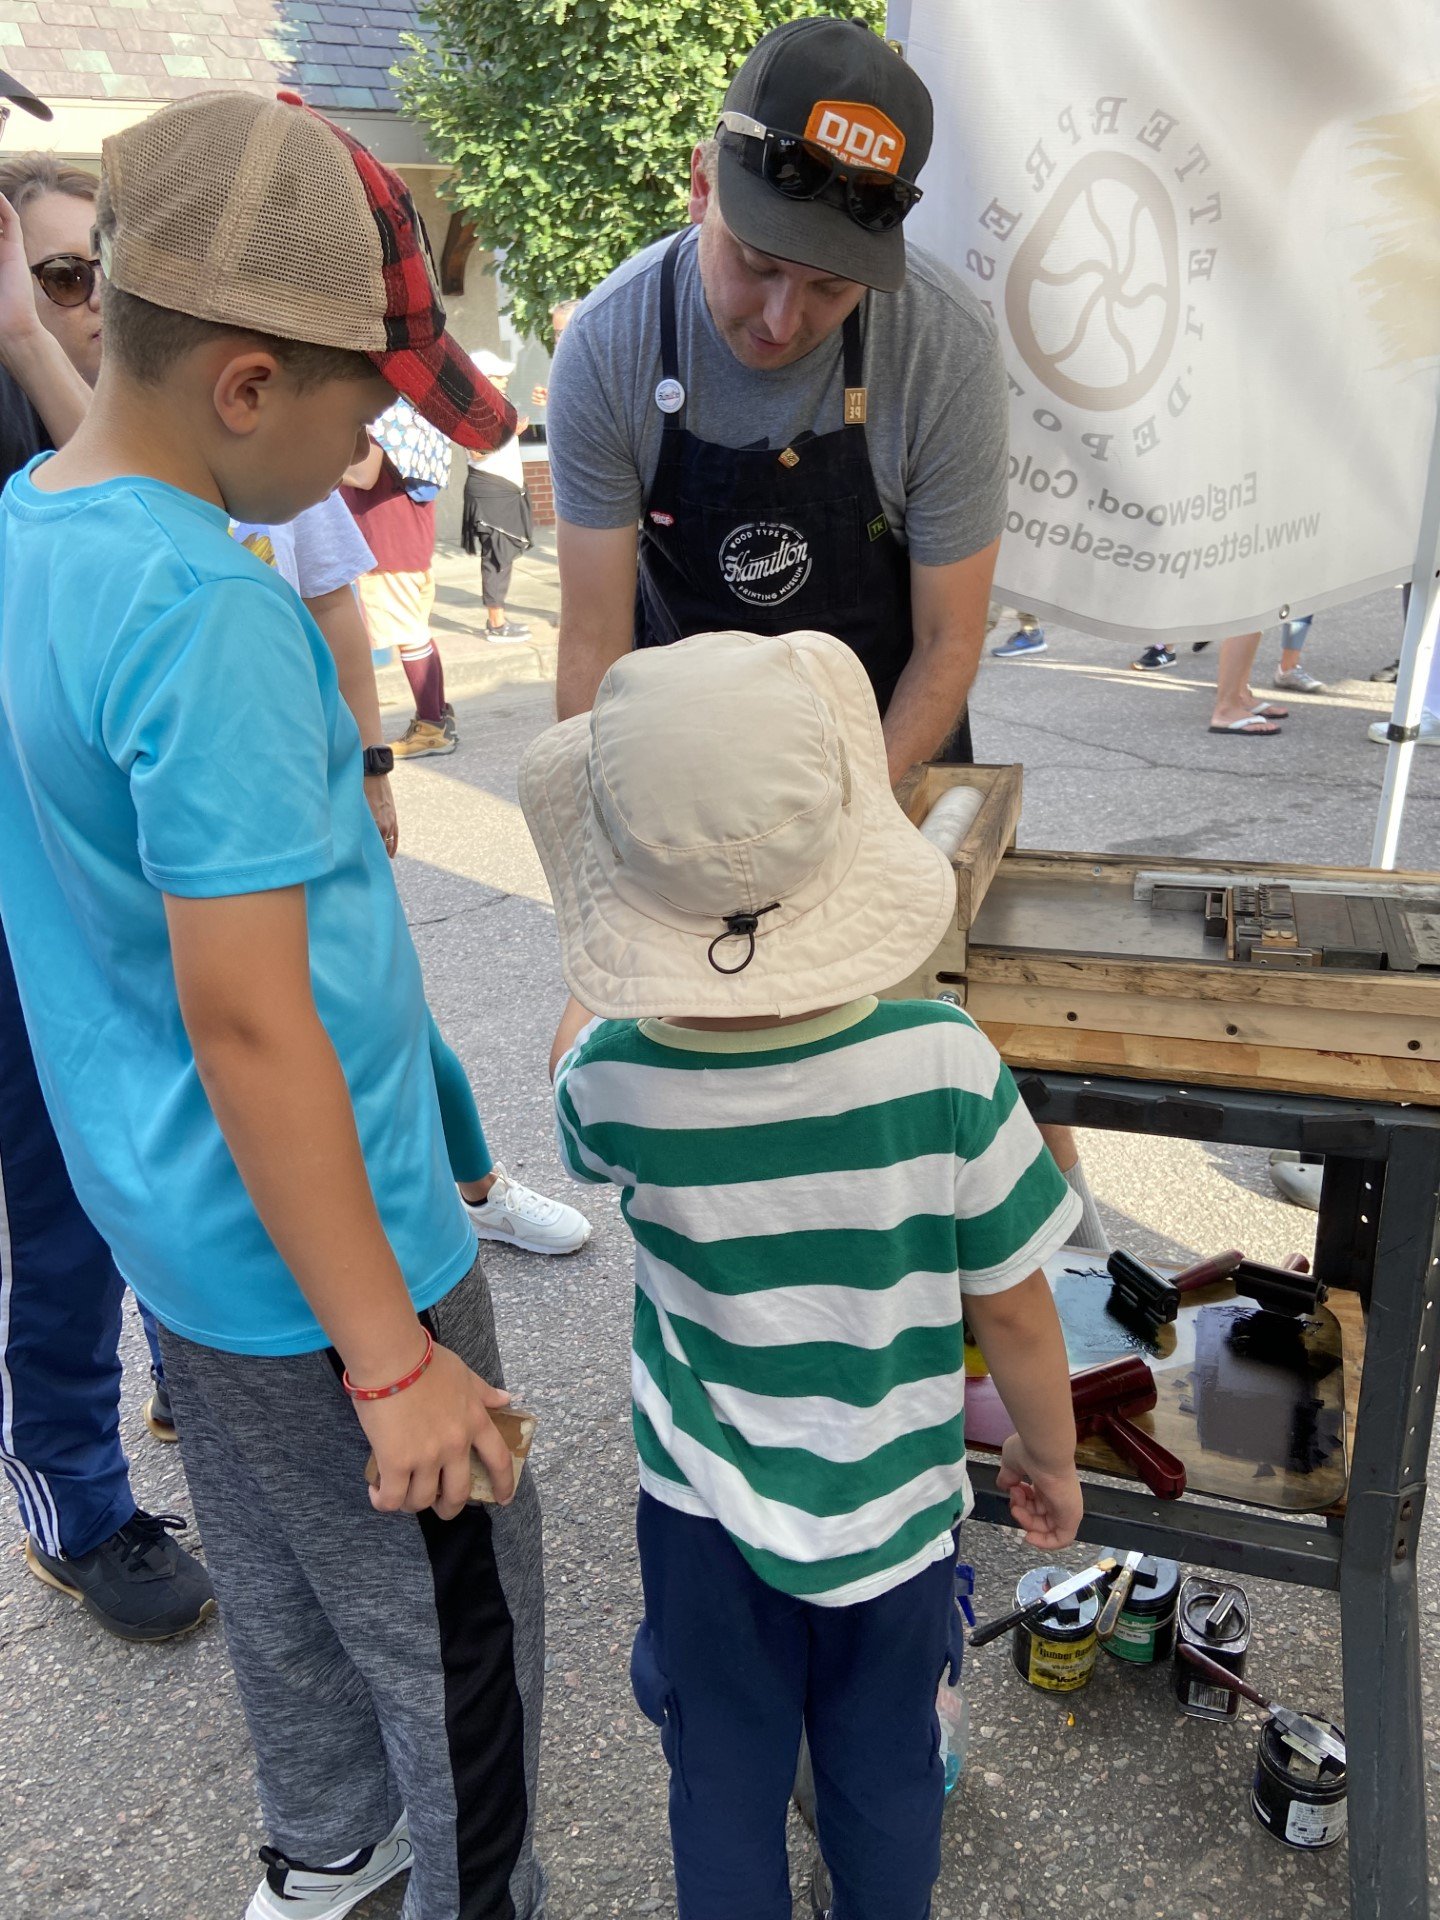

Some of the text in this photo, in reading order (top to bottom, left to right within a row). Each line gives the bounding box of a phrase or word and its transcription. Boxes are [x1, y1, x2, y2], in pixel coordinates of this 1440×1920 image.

[817, 110, 896, 167] DDC
[730, 531, 752, 549] WOOD
[755, 528, 780, 539] TYPE
[724, 540, 808, 582] Hamilton
[738, 566, 804, 601] PRINTING MUSEUM
